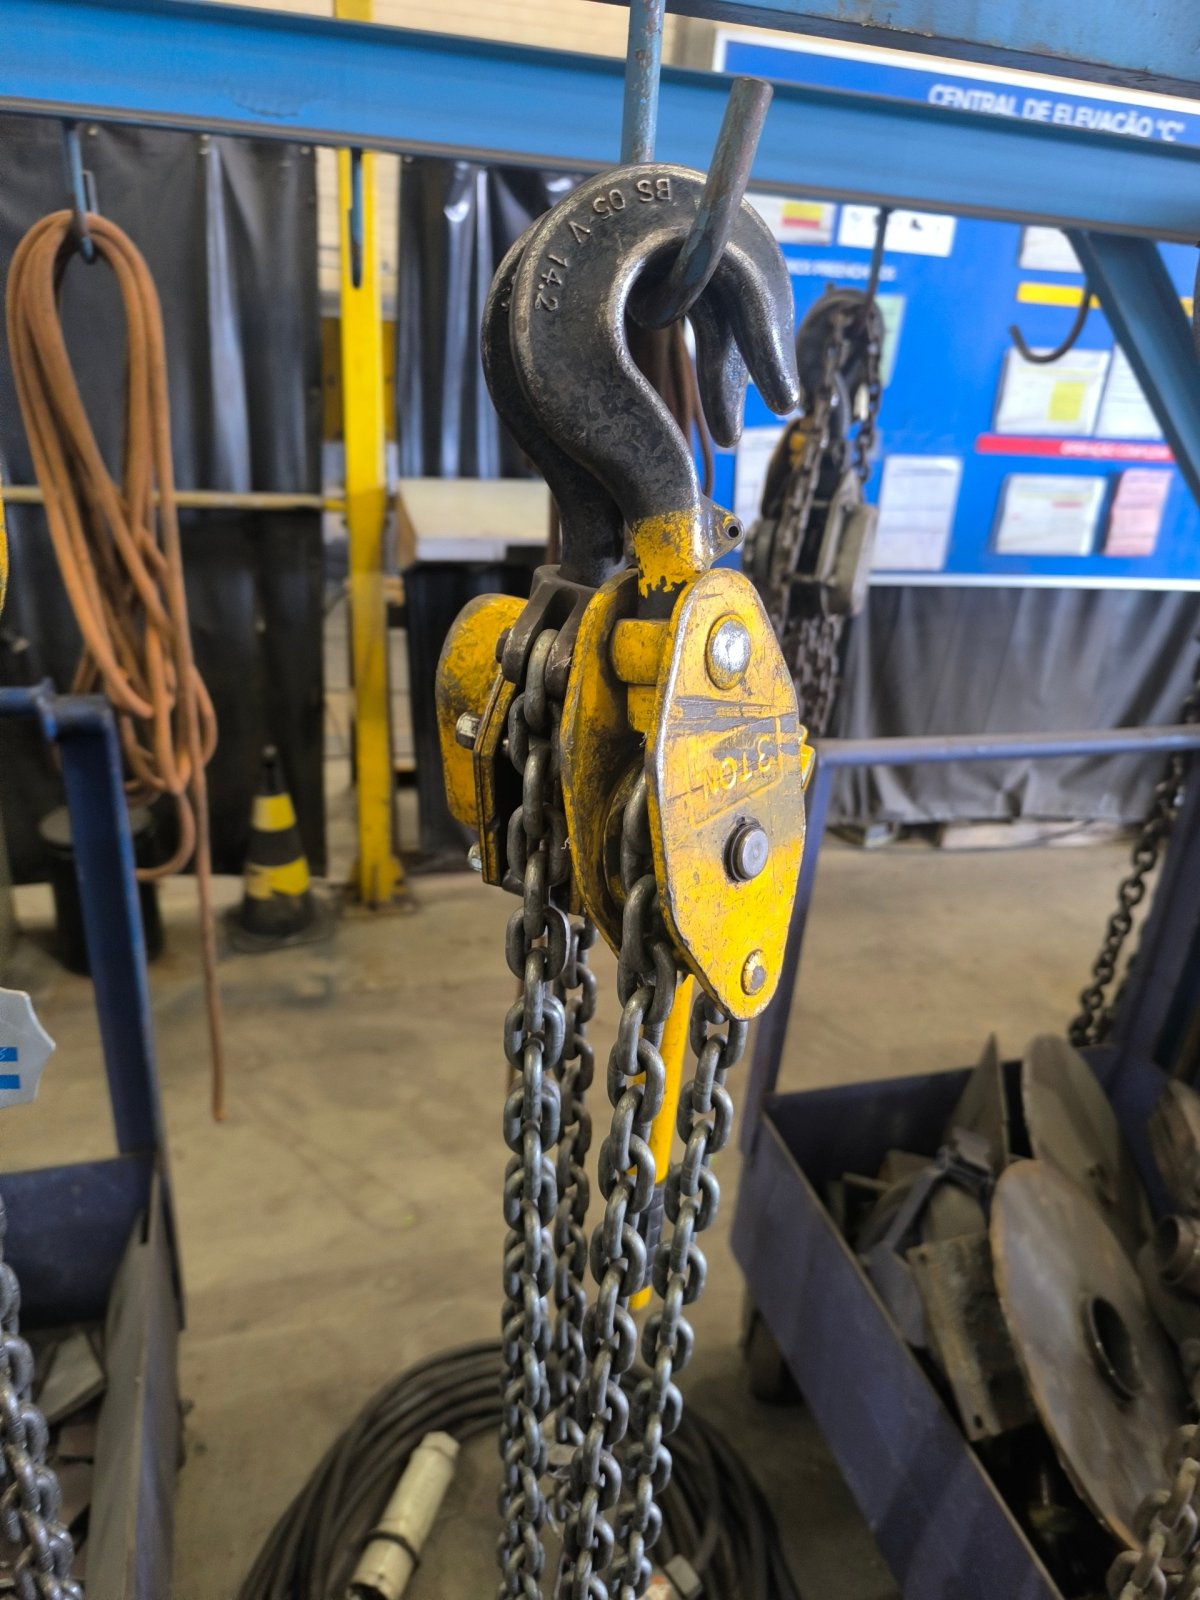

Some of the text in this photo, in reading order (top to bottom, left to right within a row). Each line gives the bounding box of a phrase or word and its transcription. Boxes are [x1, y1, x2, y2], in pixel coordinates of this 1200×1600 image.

[928, 84, 1018, 117] CENTRAL
[1022, 98, 1052, 122] DE
[637, 178, 672, 203] BS
